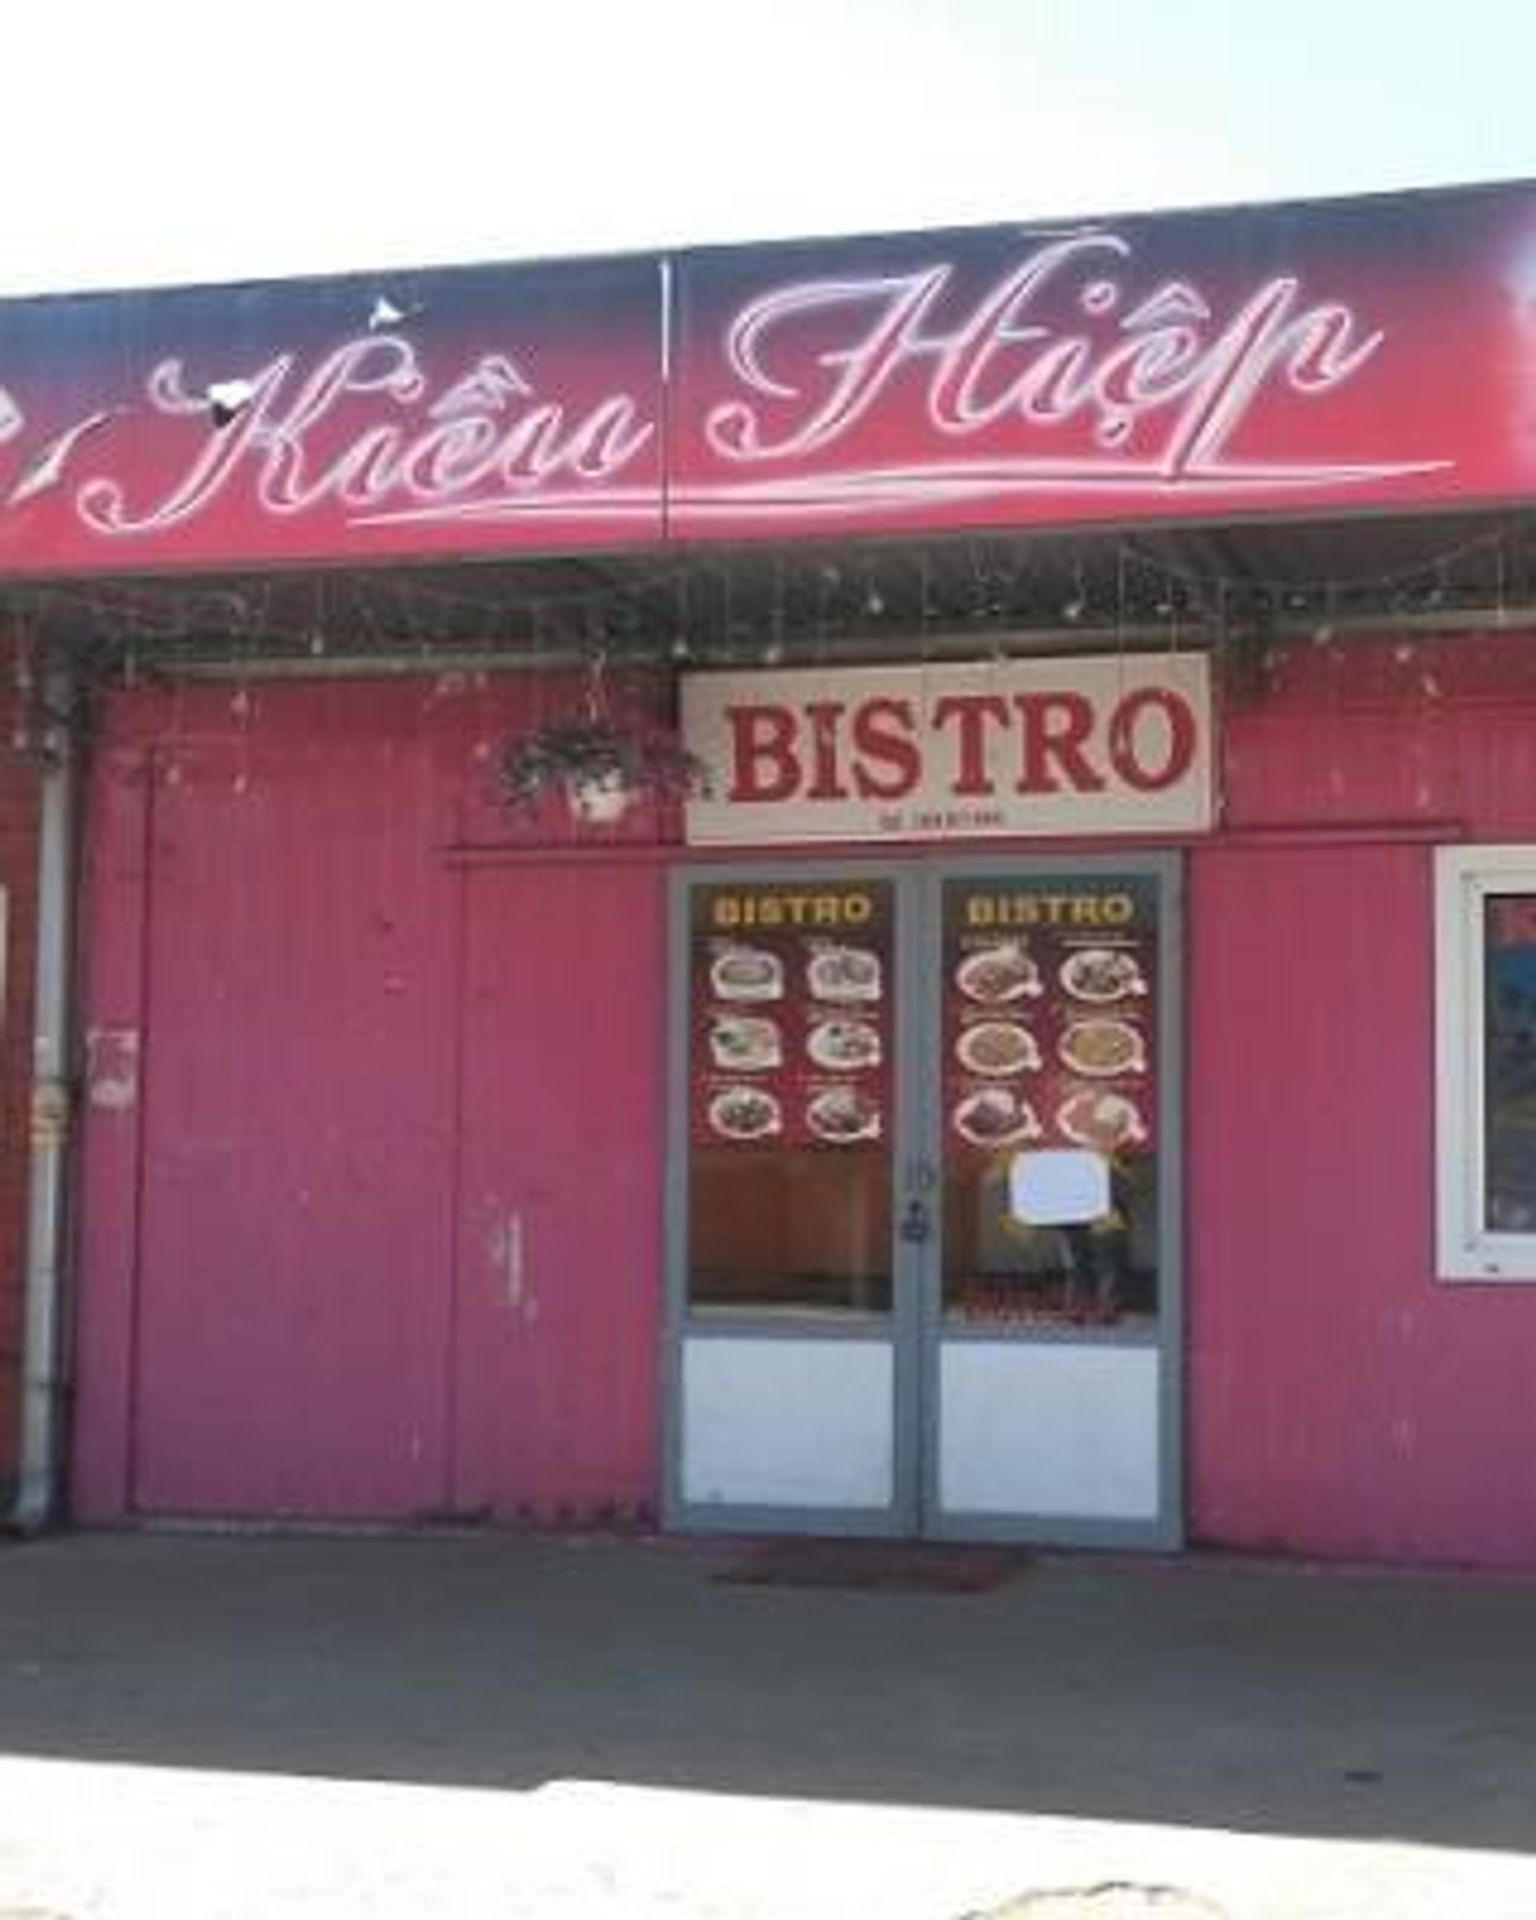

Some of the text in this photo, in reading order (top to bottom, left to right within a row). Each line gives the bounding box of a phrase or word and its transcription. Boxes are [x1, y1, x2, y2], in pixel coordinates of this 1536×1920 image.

[706, 230, 1384, 476] Hiệp
[726, 688, 1197, 802] BISTRO
[713, 893, 873, 925] BISTRO
[967, 893, 1134, 925] BISTRO
